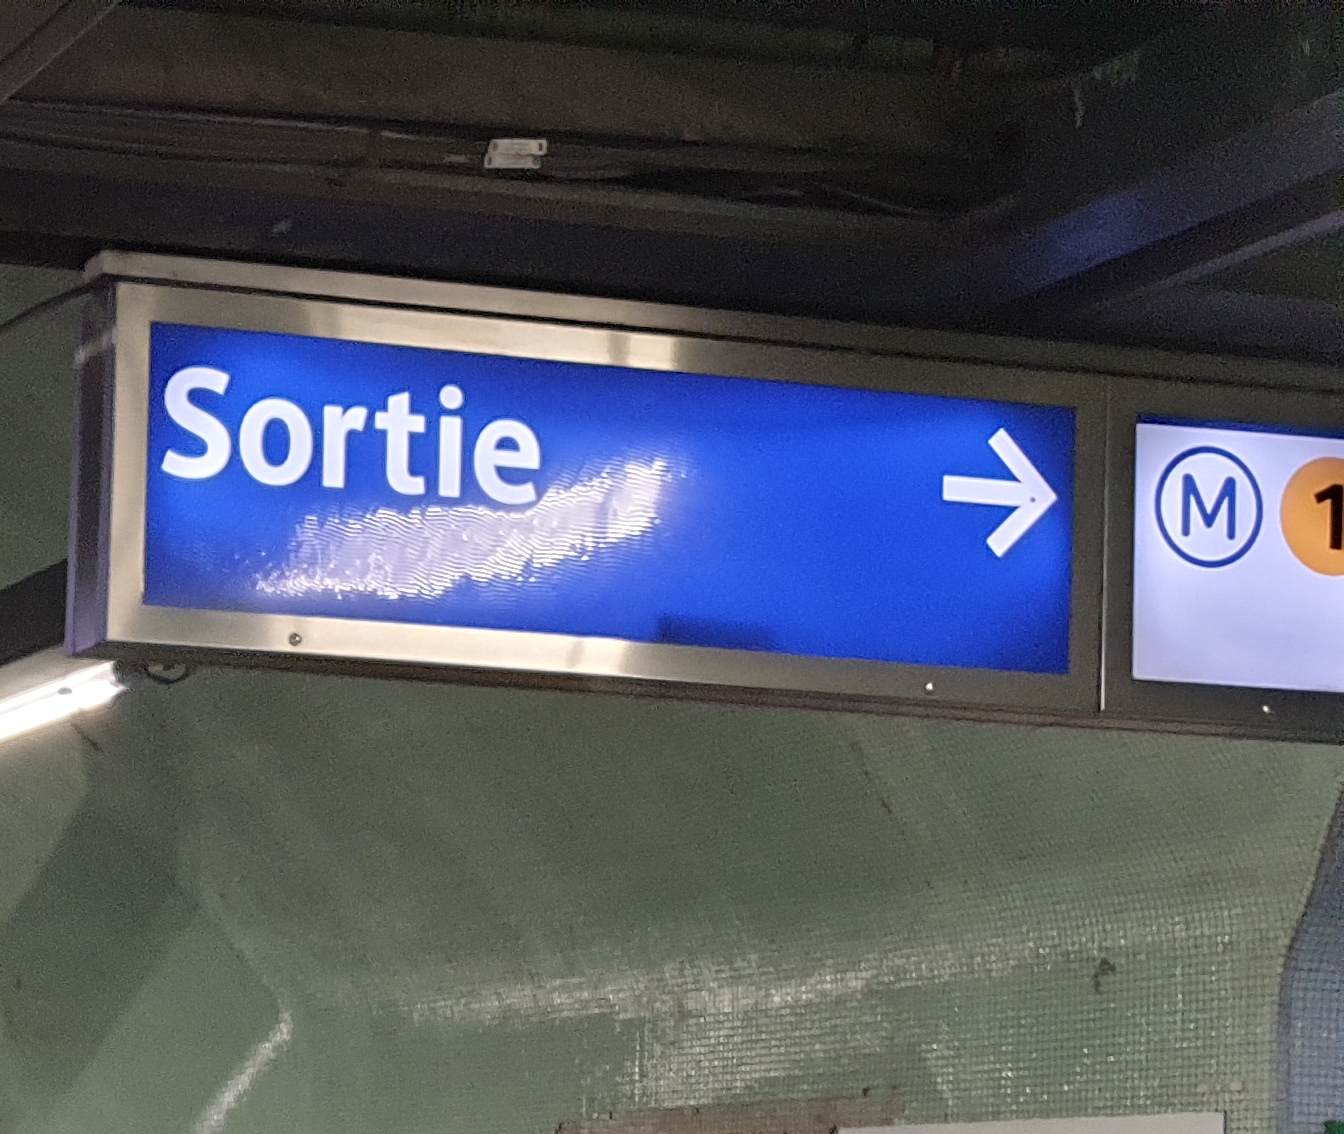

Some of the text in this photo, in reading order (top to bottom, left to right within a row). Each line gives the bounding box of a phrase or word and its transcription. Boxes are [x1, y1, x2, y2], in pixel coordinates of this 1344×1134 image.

[160, 365, 543, 506] Sortie
[1181, 472, 1344, 551] M 1
